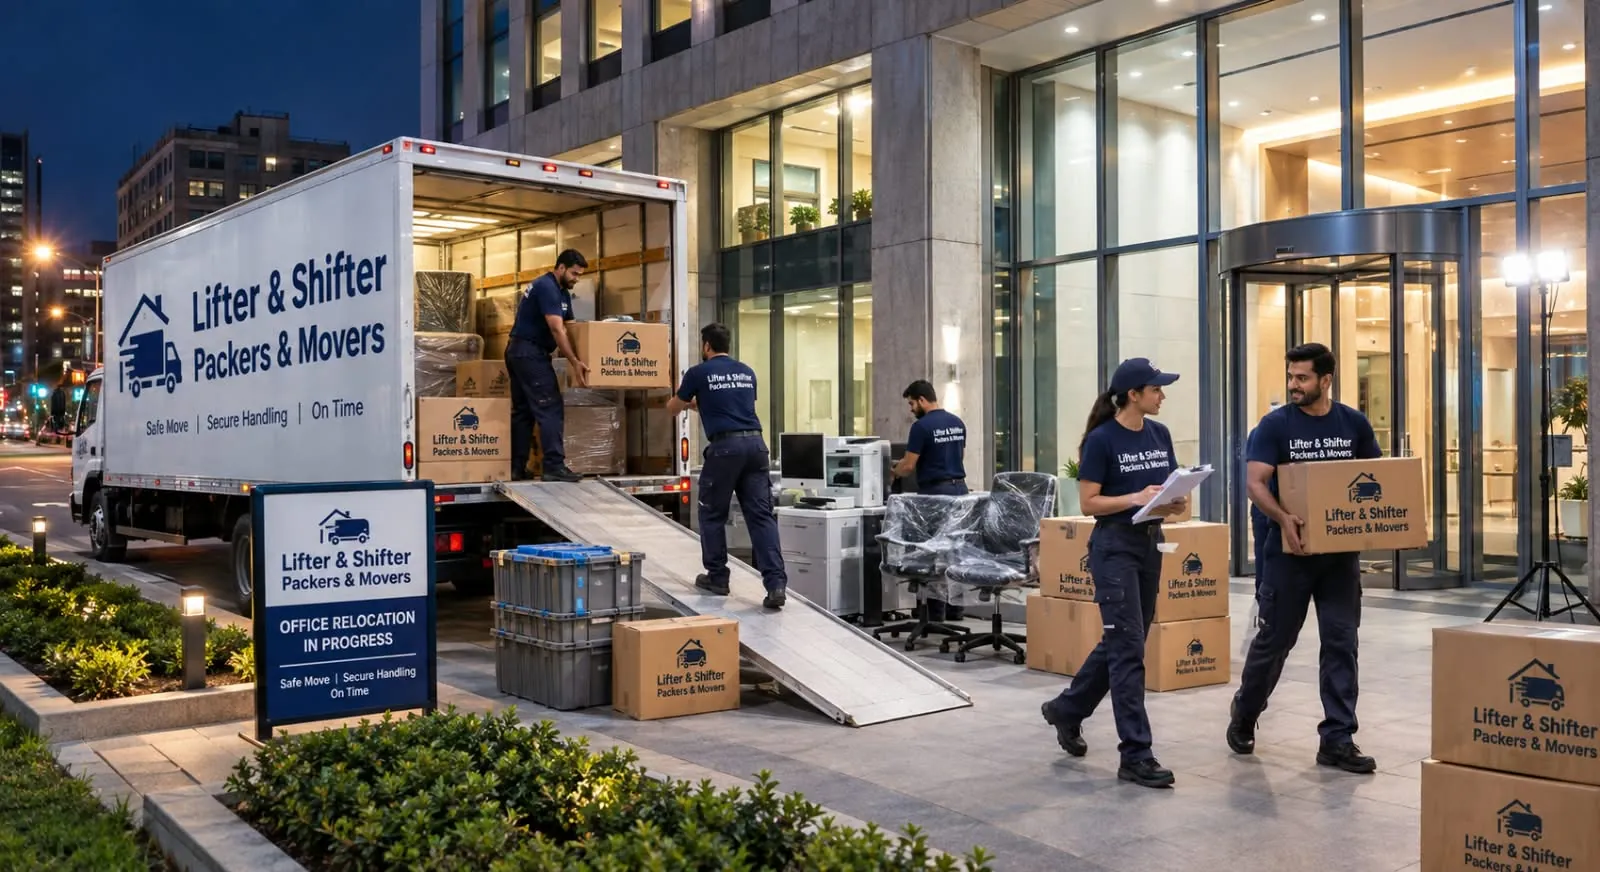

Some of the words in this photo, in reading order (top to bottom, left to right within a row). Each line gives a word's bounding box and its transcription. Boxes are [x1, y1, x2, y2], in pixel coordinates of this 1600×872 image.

[193, 282, 260, 332] Lifter
[268, 270, 286, 314] &
[292, 251, 387, 309] Shifter
[194, 341, 271, 382] Packers
[277, 330, 292, 368] &
[299, 322, 385, 364] Movers
[601, 357, 622, 366] Lifter
[624, 358, 630, 366] &
[631, 357, 657, 367] Shifter
[601, 368, 626, 376] Packers
[146, 420, 164, 436] Safe
[166, 419, 189, 434] Move
[207, 414, 239, 430] Secure
[242, 407, 288, 427] Handling
[312, 401, 329, 419] On
[332, 399, 364, 418] Time
[433, 434, 458, 445] Lifter
[460, 434, 466, 444] &
[469, 434, 499, 445] Shifter
[1290, 439, 1313, 449] Lifter
[1315, 438, 1321, 448] &
[1323, 437, 1352, 447] Shifter
[433, 447, 462, 456] Packers
[464, 447, 469, 455] &
[471, 447, 499, 456] Movers
[1290, 450, 1318, 459] Packers
[1320, 450, 1325, 458] &
[1325, 508, 1355, 521] Lifter
[1359, 508, 1366, 519] &
[1370, 506, 1408, 519] Shifter
[1326, 523, 1362, 535] Packers
[1365, 522, 1372, 532] &
[1375, 522, 1409, 532] Movers
[282, 552, 331, 572] Lifter
[336, 552, 348, 568] &
[353, 548, 412, 568] Shifter
[282, 573, 340, 591] Packers
[344, 572, 355, 587] &
[359, 571, 411, 586] Movers
[1060, 573, 1083, 584] Lifter
[1168, 579, 1186, 589] Lifter
[280, 617, 329, 634] OFFICE
[332, 611, 416, 630] RELOCATION
[304, 638, 318, 652] IN
[322, 632, 393, 651] PROGRESS
[280, 677, 302, 689] Safe
[304, 675, 330, 687] Move
[343, 671, 375, 683] Secure
[377, 667, 417, 679] Handling
[657, 674, 683, 685] Lifter
[686, 672, 692, 682] &
[694, 670, 725, 682] Shifter
[330, 687, 344, 698] On
[346, 686, 369, 697] Time
[657, 687, 688, 697] Packers
[698, 684, 725, 693] Movers
[1474, 707, 1518, 728] Lifter
[1523, 714, 1534, 730] &
[1540, 716, 1598, 739] Shifter
[1473, 728, 1526, 749] Packers
[1531, 736, 1541, 751] &
[1545, 739, 1597, 758] Movers
[1465, 834, 1503, 854] Lifter
[1507, 843, 1517, 857] &
[1522, 846, 1572, 868] Shifter
[1465, 853, 1511, 872] Packers
